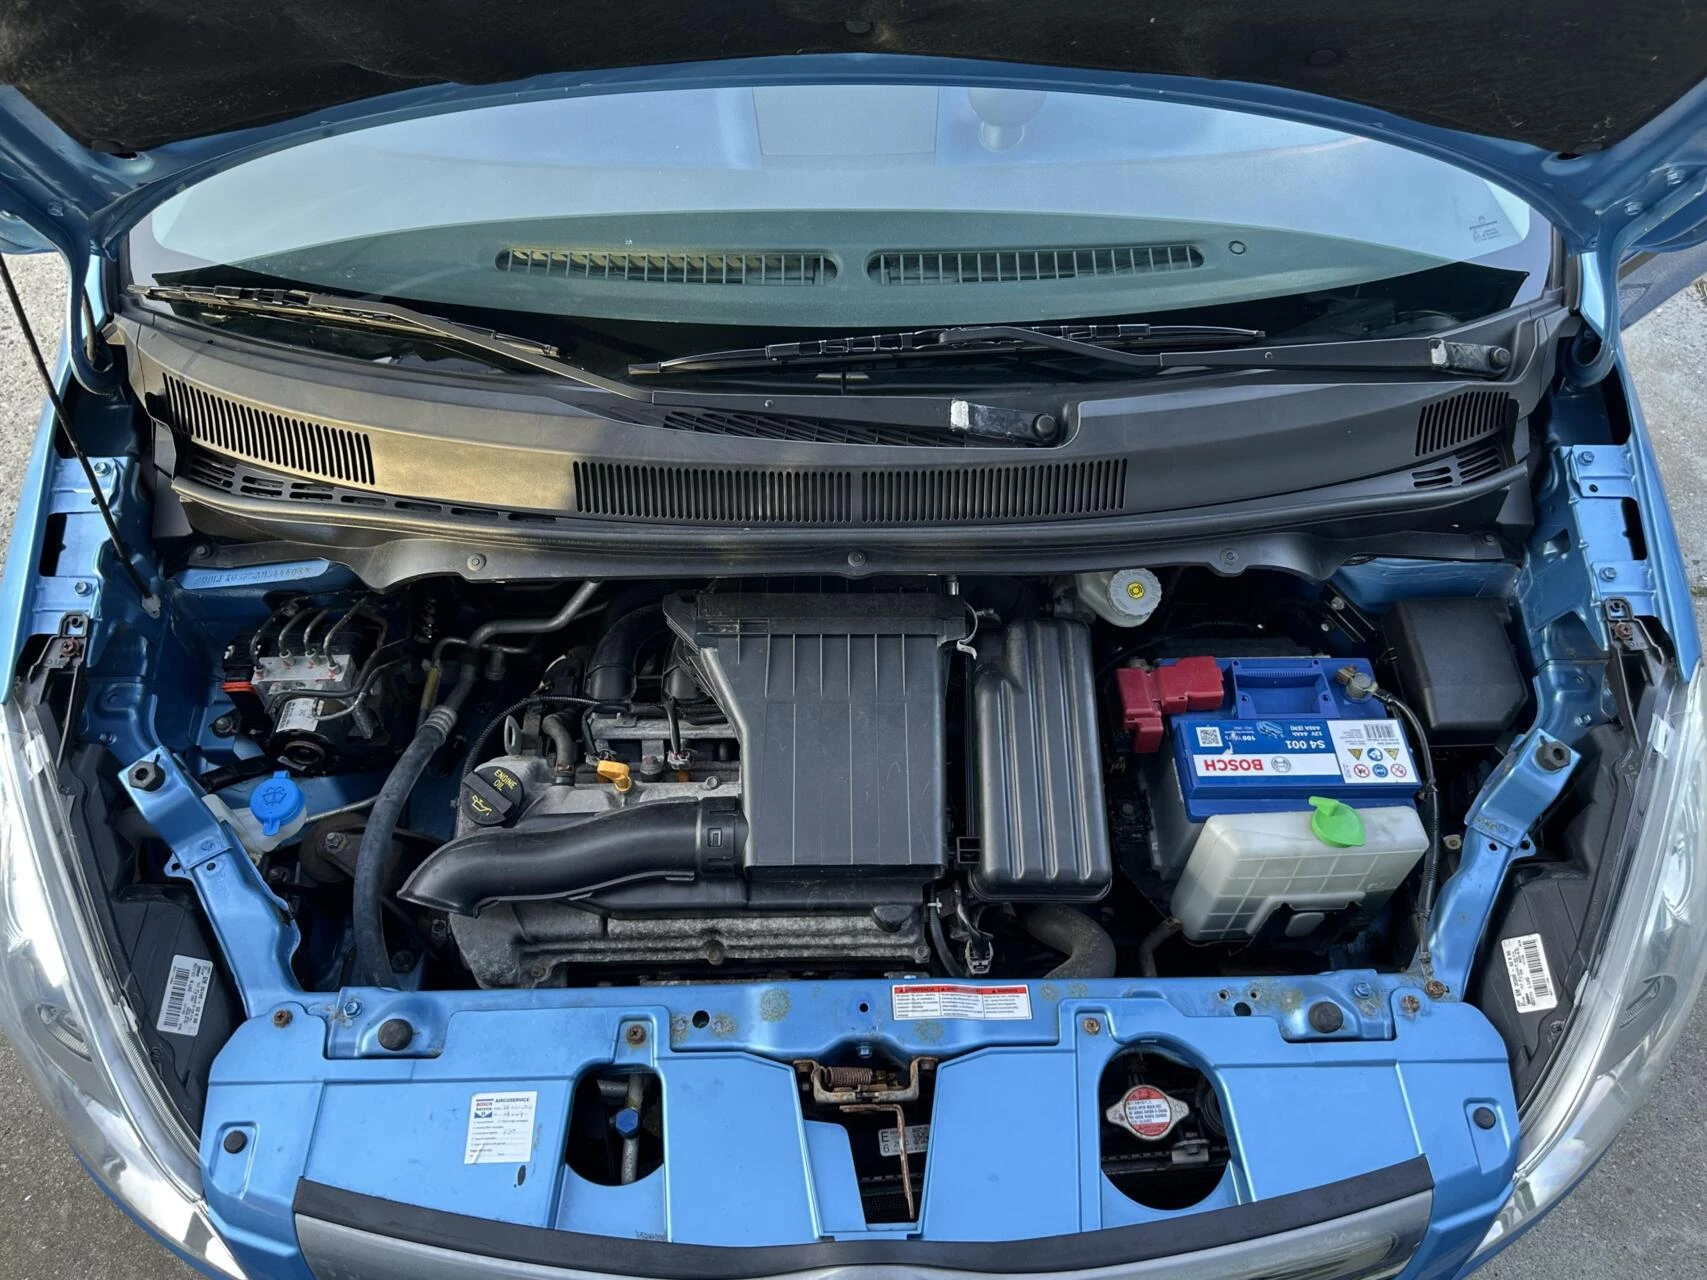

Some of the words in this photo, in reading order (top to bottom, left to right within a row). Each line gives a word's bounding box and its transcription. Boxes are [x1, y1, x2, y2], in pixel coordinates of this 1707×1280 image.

[1285, 740, 1307, 749] 001
[1309, 740, 1326, 749] S4
[1203, 759, 1264, 771] BOSCH
[494, 769, 518, 790] ENGINE
[493, 780, 504, 791] OIL
[881, 1132, 889, 1142] E
